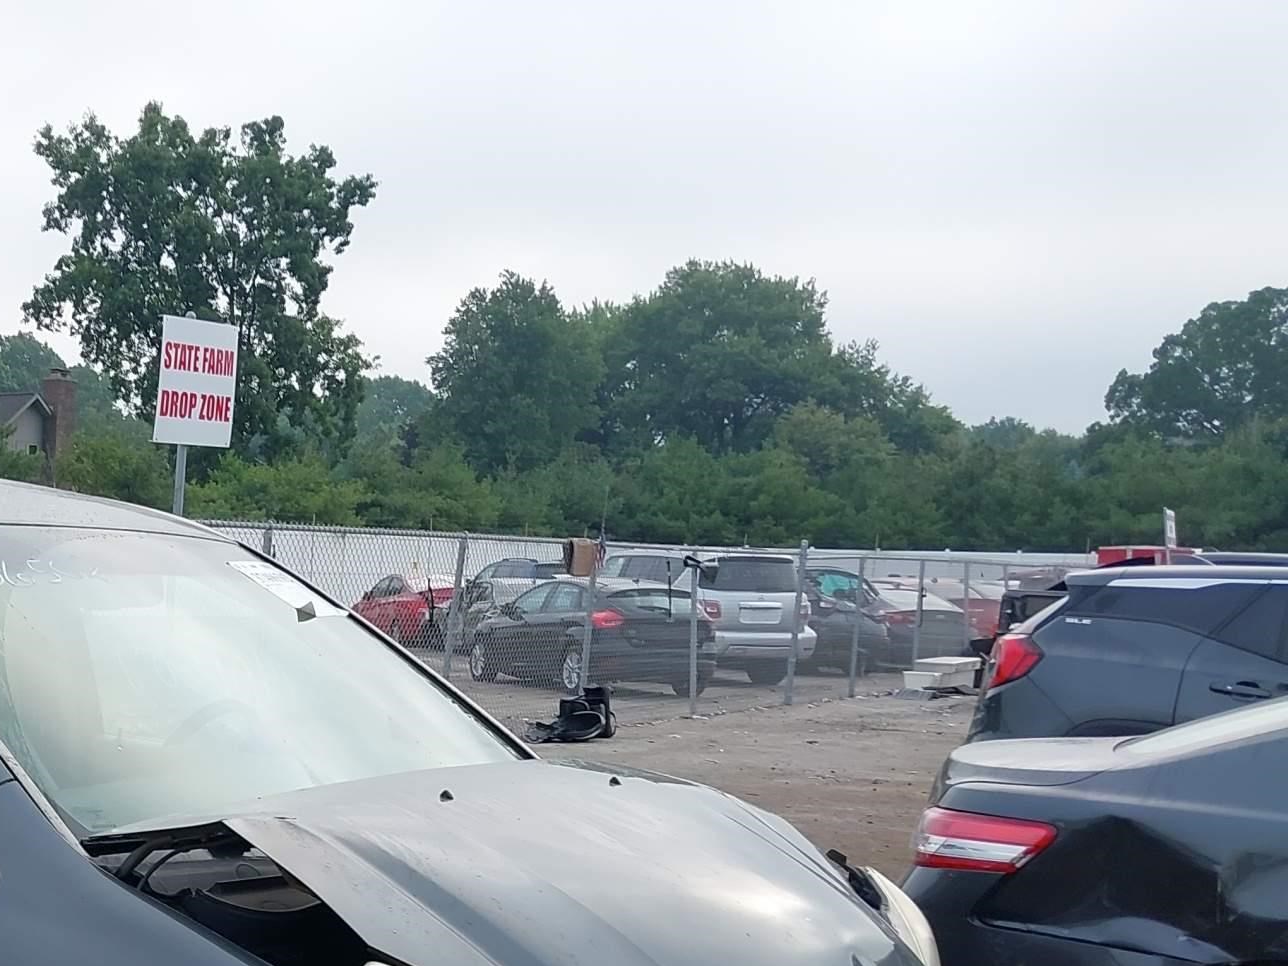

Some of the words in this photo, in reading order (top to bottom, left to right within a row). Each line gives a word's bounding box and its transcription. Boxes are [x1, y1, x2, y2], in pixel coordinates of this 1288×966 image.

[164, 341, 200, 372] STATE
[202, 347, 234, 376] FARM
[160, 390, 197, 419] DROP
[199, 394, 231, 422] ZONE
